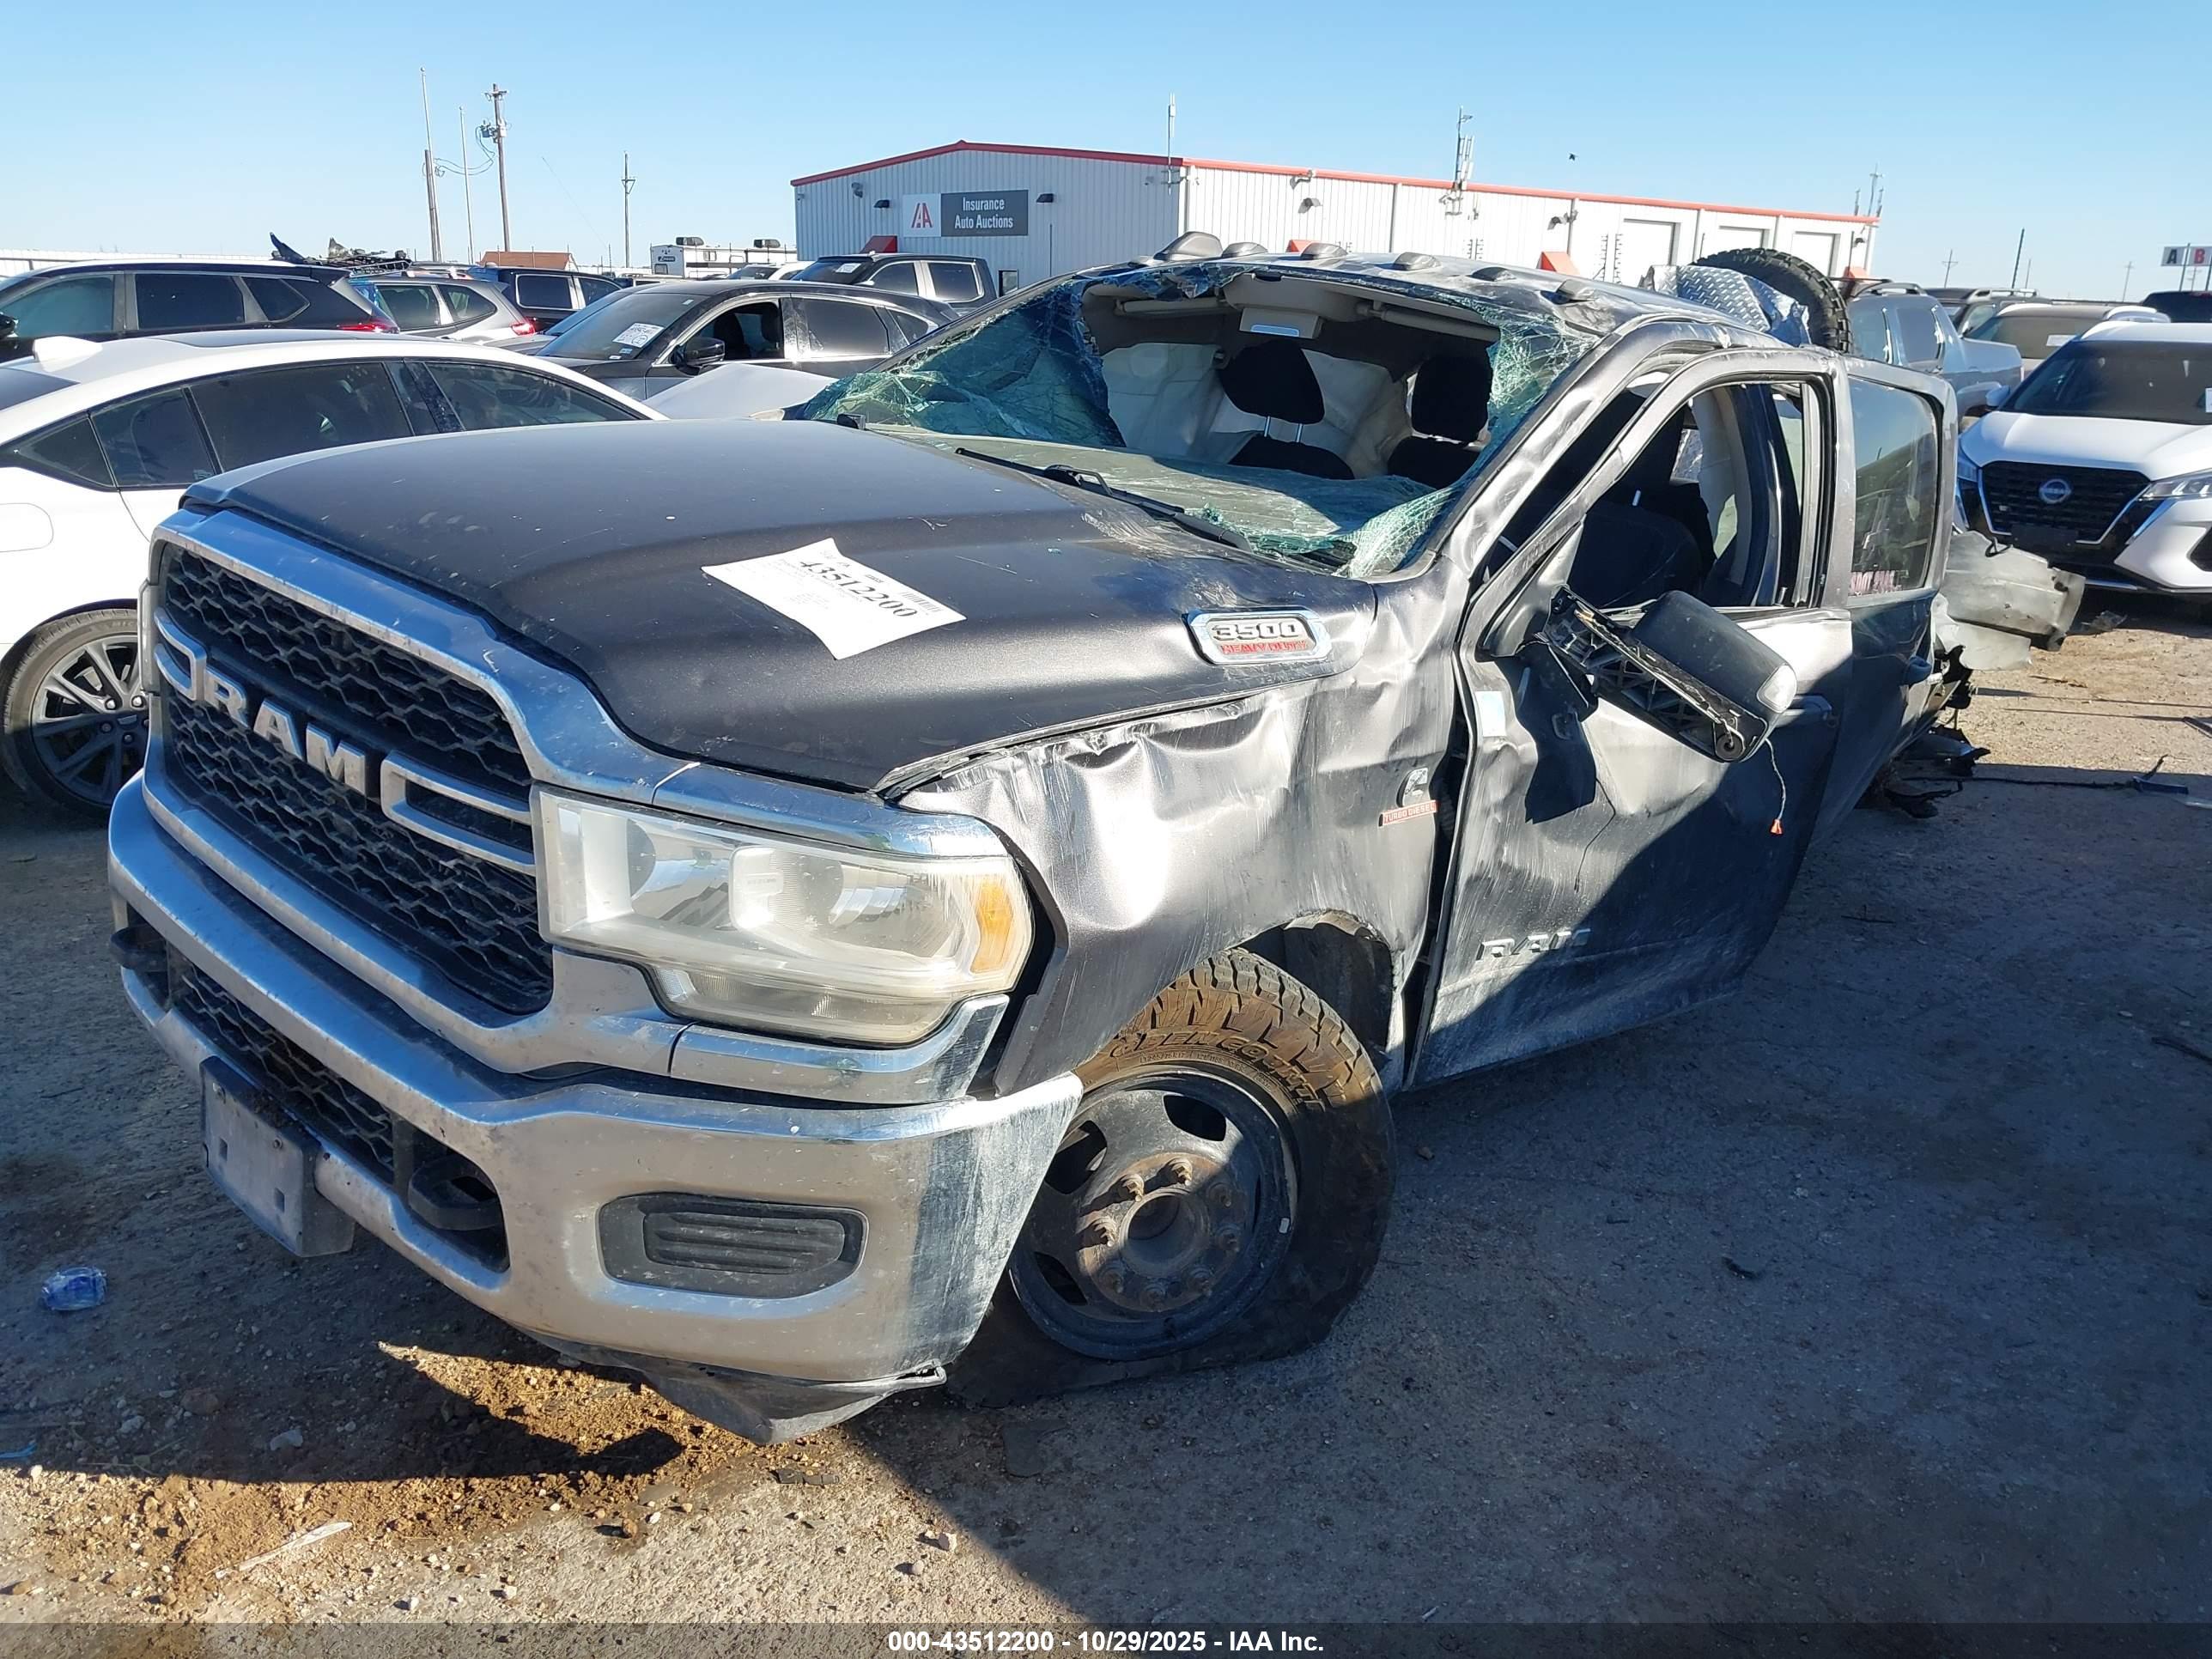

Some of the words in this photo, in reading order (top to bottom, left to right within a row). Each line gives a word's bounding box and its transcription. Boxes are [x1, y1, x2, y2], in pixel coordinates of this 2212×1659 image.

[963, 197, 1005, 211] Insurance
[954, 215, 975, 229] Auto
[975, 214, 1014, 229] Auctions
[2166, 248, 2178, 264] A
[2193, 248, 2206, 264] B
[799, 562, 918, 617] 43512200
[1212, 622, 1301, 641] 3500
[1220, 642, 1266, 655] HEAVY
[204, 665, 367, 795] RAM
[1383, 811, 1407, 823] TURBO
[1408, 802, 1436, 816] DIESEL
